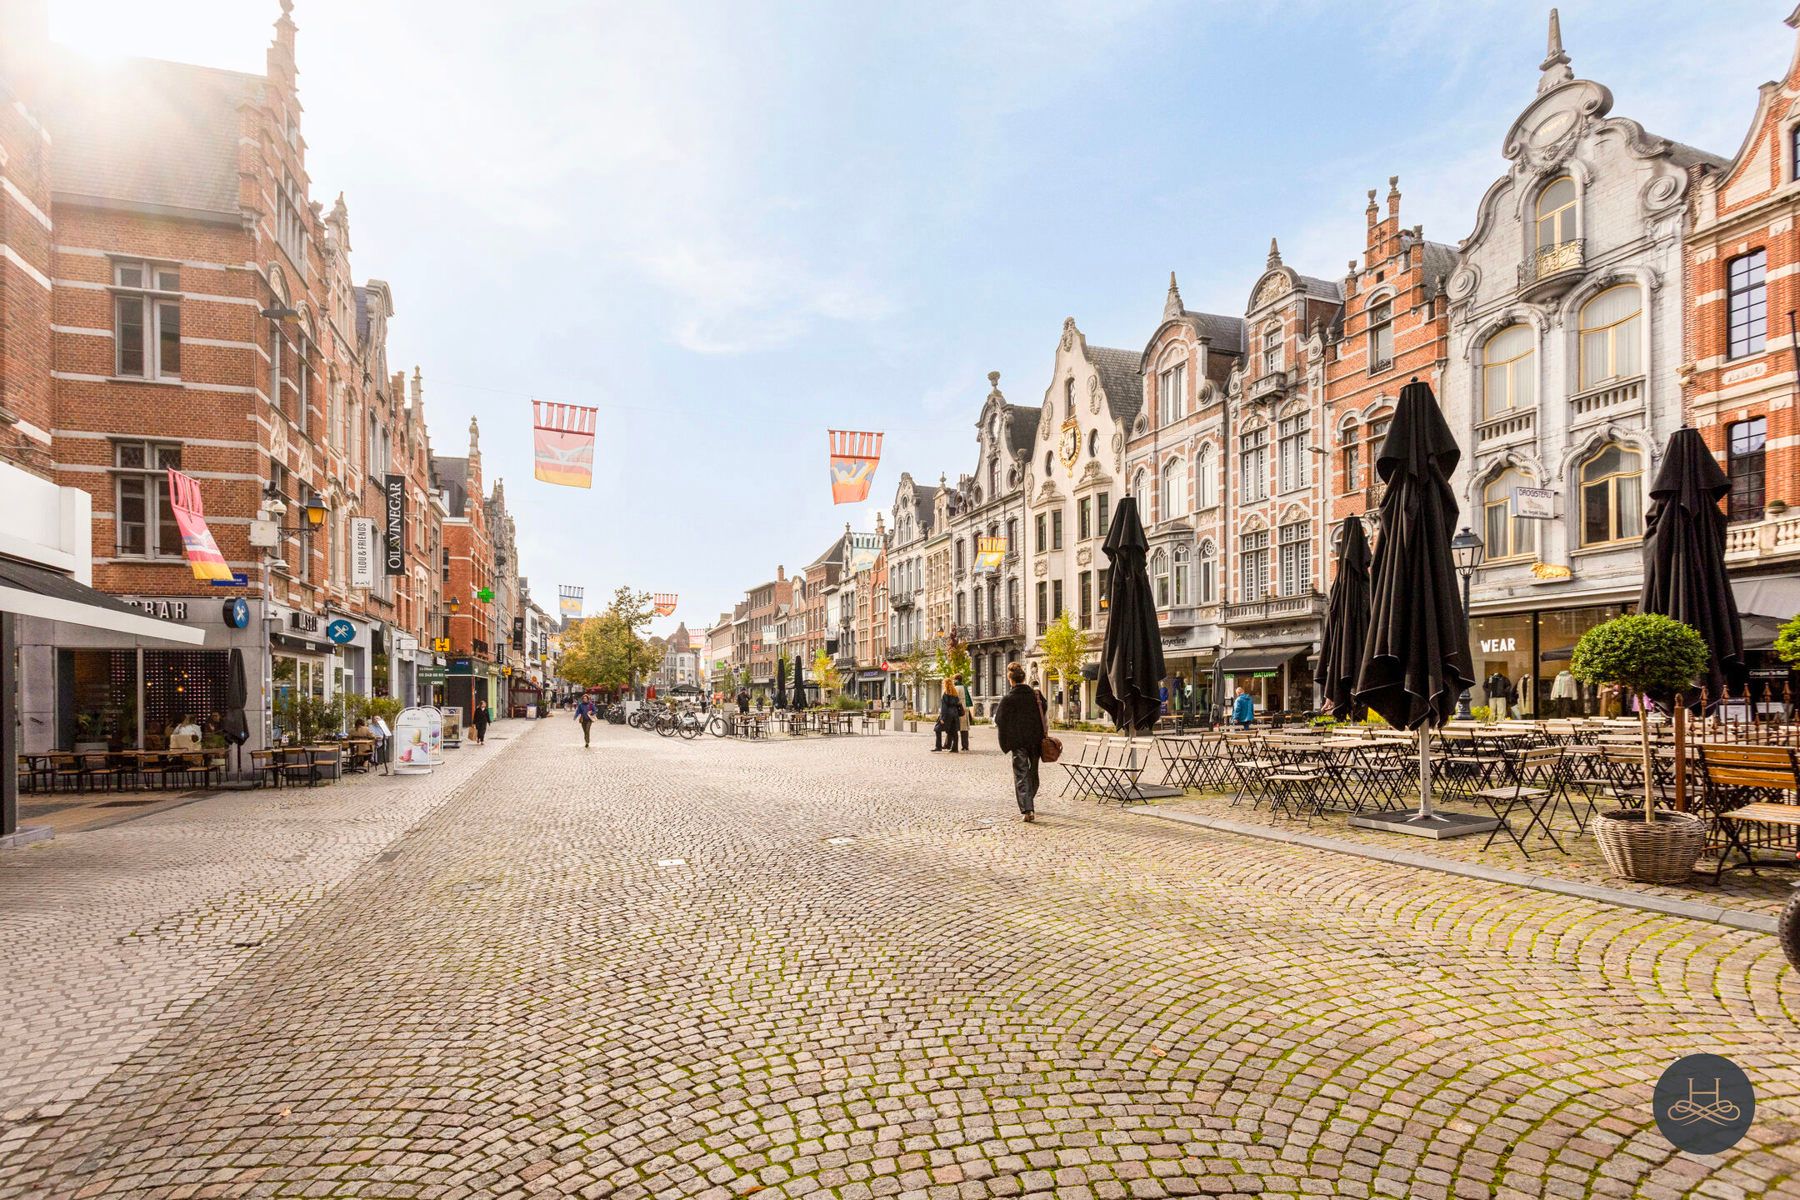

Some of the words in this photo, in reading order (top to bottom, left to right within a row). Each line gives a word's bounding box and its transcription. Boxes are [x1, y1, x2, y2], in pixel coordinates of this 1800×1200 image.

[357, 522, 367, 550] FRIENDS
[357, 556, 367, 574] FILOU
[1480, 638, 1516, 653] WEAR
